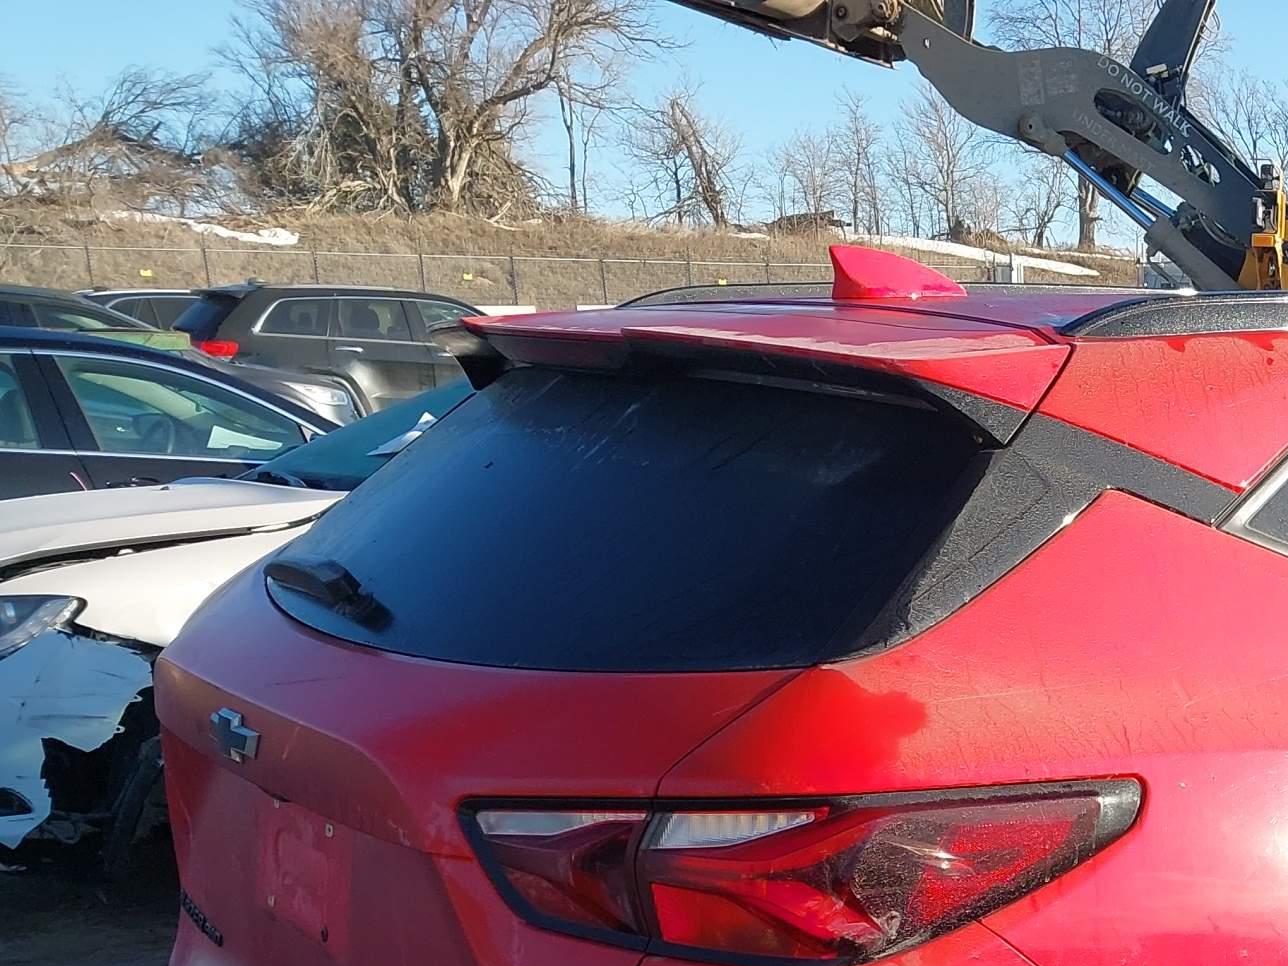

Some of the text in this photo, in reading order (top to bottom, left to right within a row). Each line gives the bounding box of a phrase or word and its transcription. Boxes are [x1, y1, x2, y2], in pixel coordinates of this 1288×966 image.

[1097, 56, 1192, 138] DO NOT WALK
